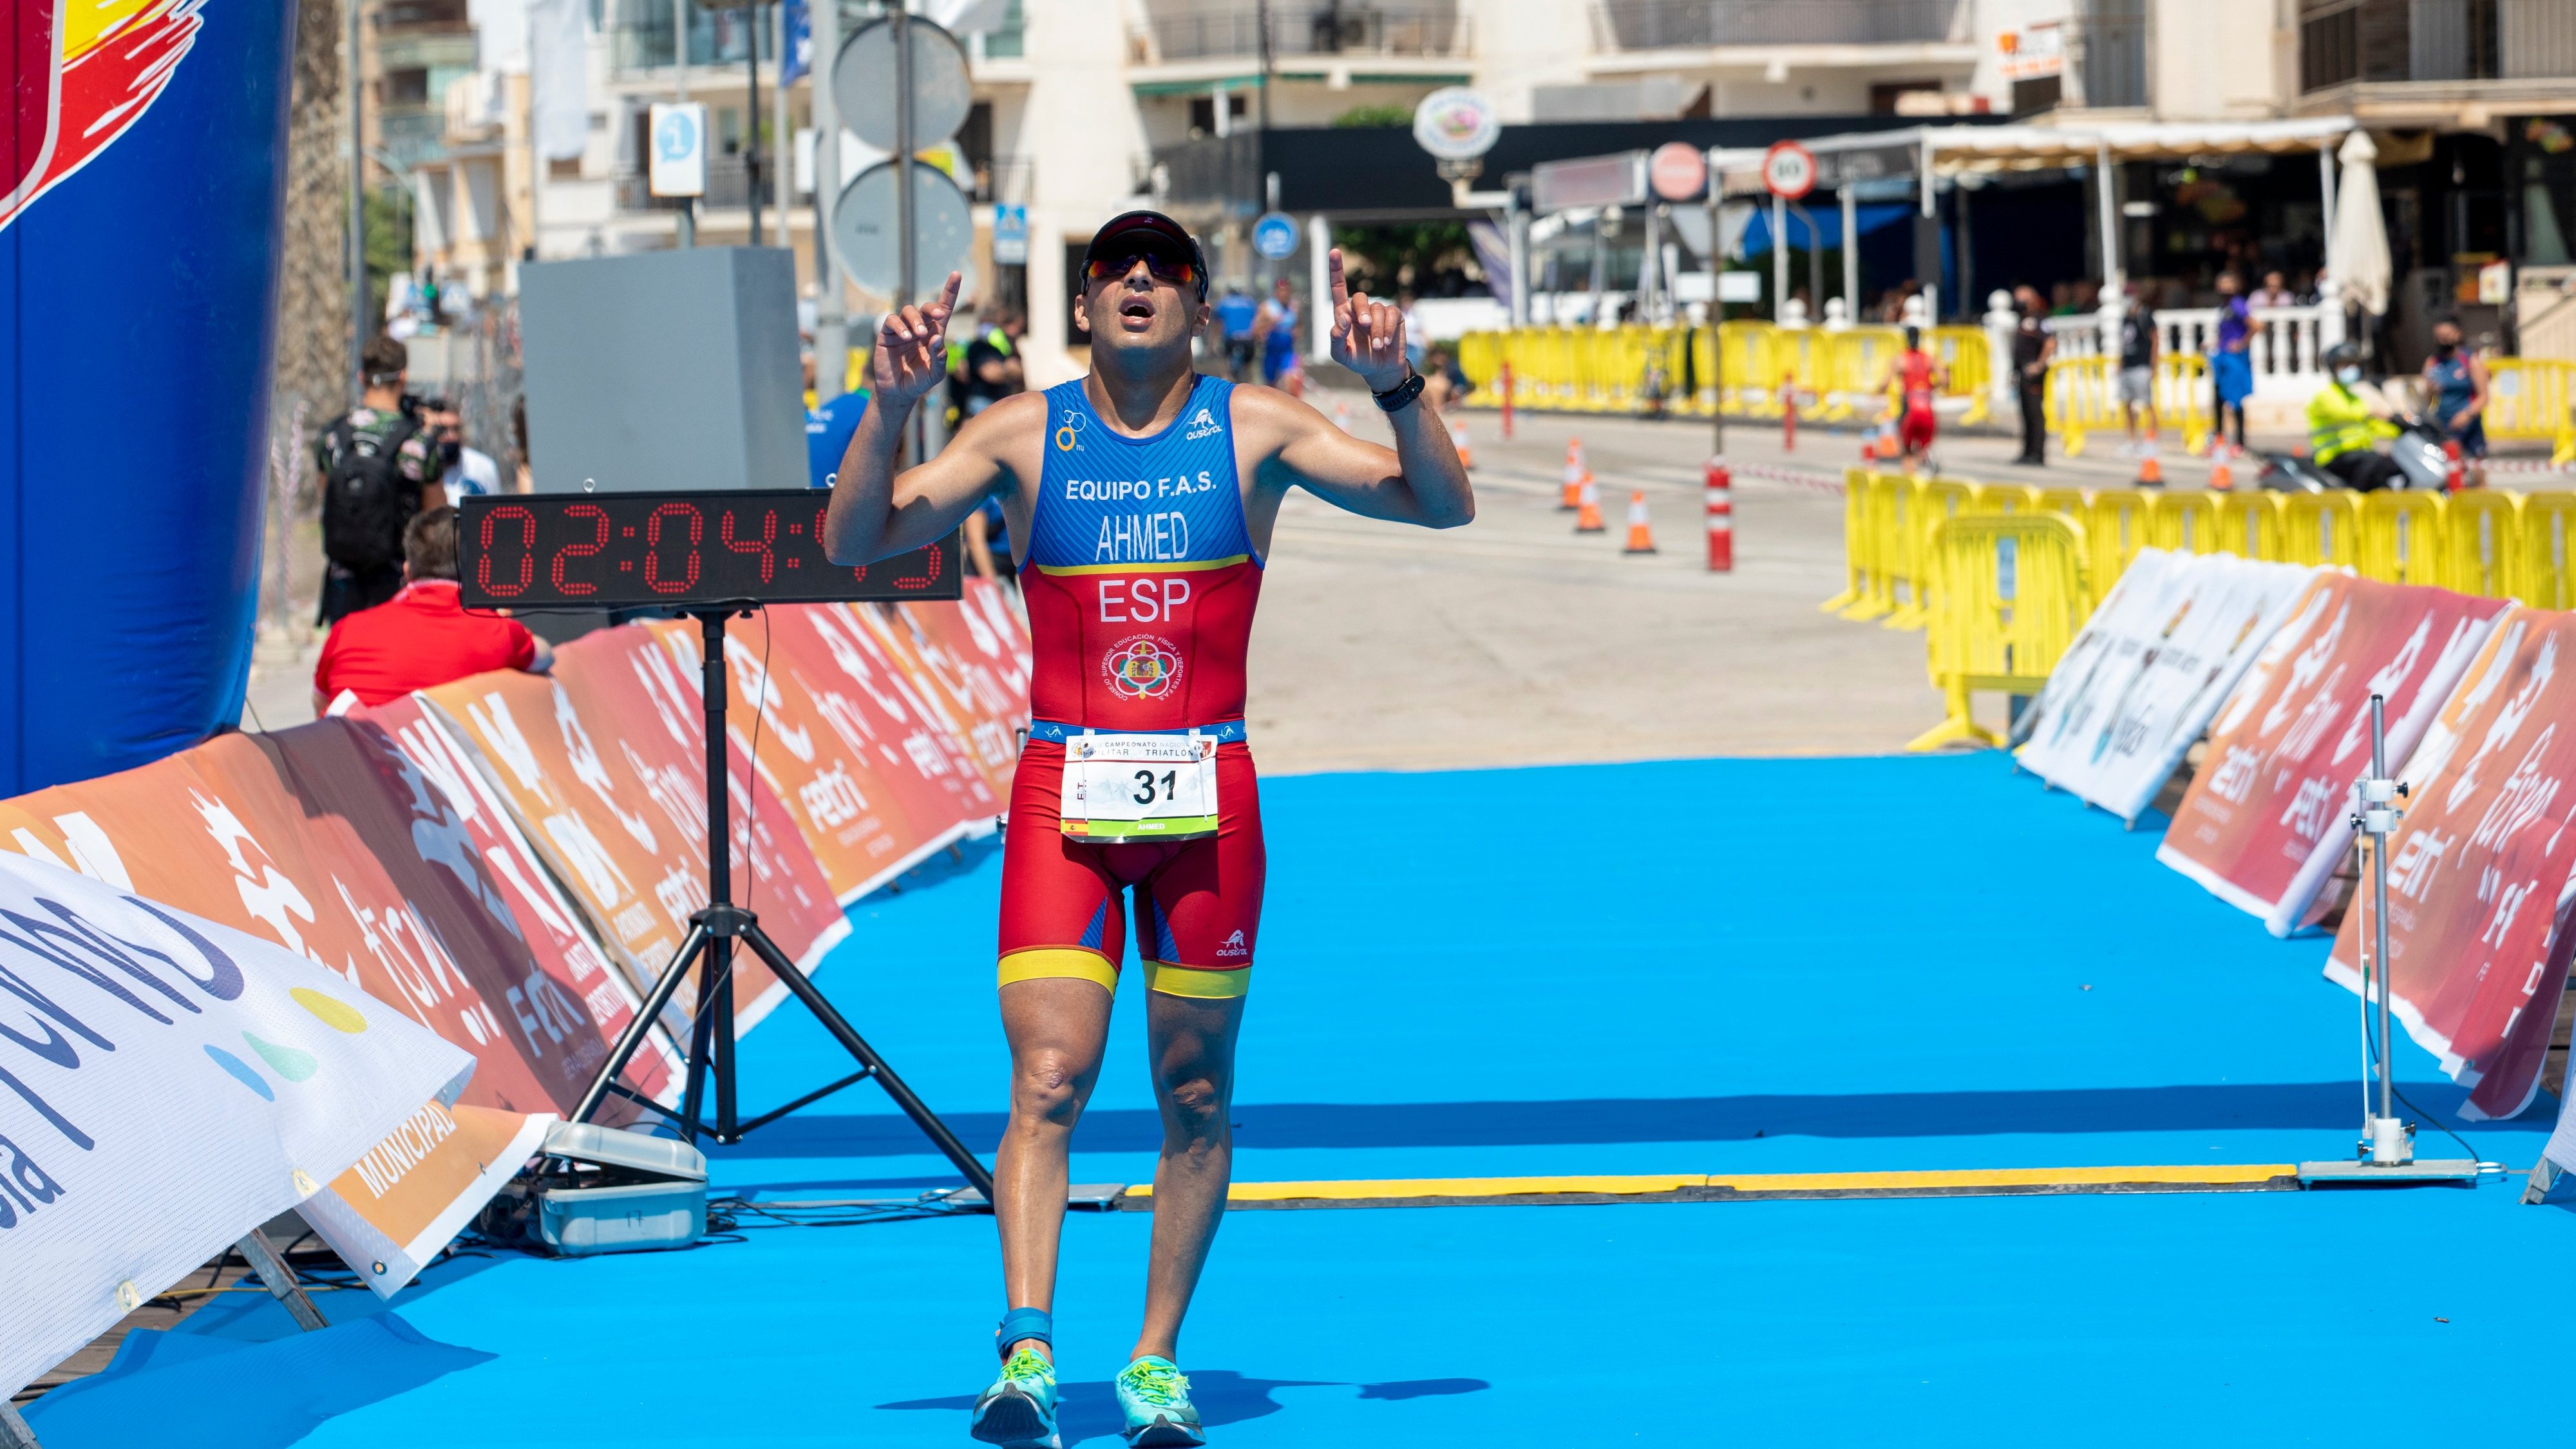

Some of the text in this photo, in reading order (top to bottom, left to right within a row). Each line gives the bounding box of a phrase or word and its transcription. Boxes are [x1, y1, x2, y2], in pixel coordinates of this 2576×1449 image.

[1186, 424, 1222, 440] austral
[1066, 471, 1217, 502] EQUIPO F.A.S.
[1095, 512, 1188, 562] AHMED
[1099, 578, 1190, 623] ESP
[1113, 633, 1155, 649] EDUCACIÓN
[1157, 636, 1177, 652] FÍSICA
[1101, 648, 1115, 677] SUPERIOR
[1172, 657, 1184, 689] DEPORTES
[1104, 678, 1128, 701] CONSEJO
[1133, 770, 1176, 804] 31
[1216, 948, 1247, 956] austral
[353, 1104, 457, 1200] MUNICIPAL
